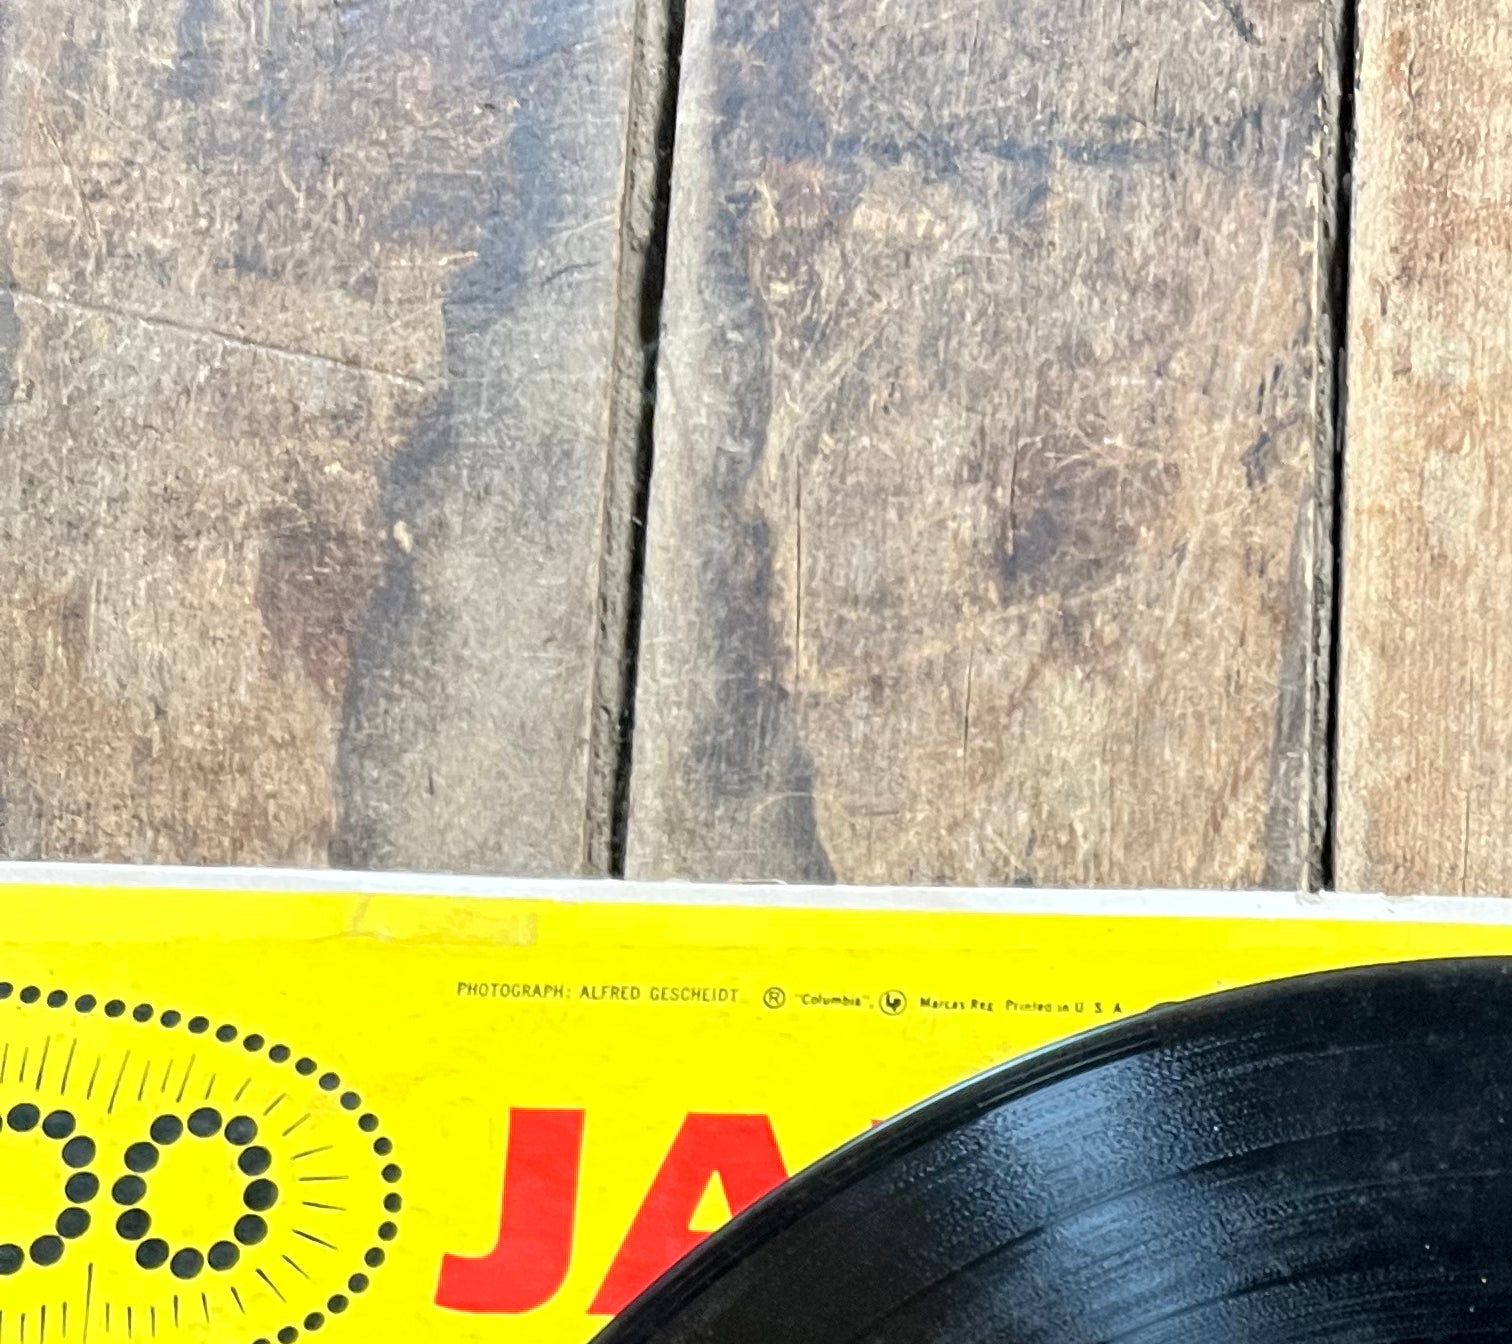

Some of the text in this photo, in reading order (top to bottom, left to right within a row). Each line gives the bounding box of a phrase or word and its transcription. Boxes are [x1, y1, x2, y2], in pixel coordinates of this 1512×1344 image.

[457, 982, 571, 999] PHOTOGRAPH:
[580, 985, 641, 1001] ALFRED
[650, 987, 740, 1003] GESCHEIDT
[434, 1106, 790, 1316] JA
